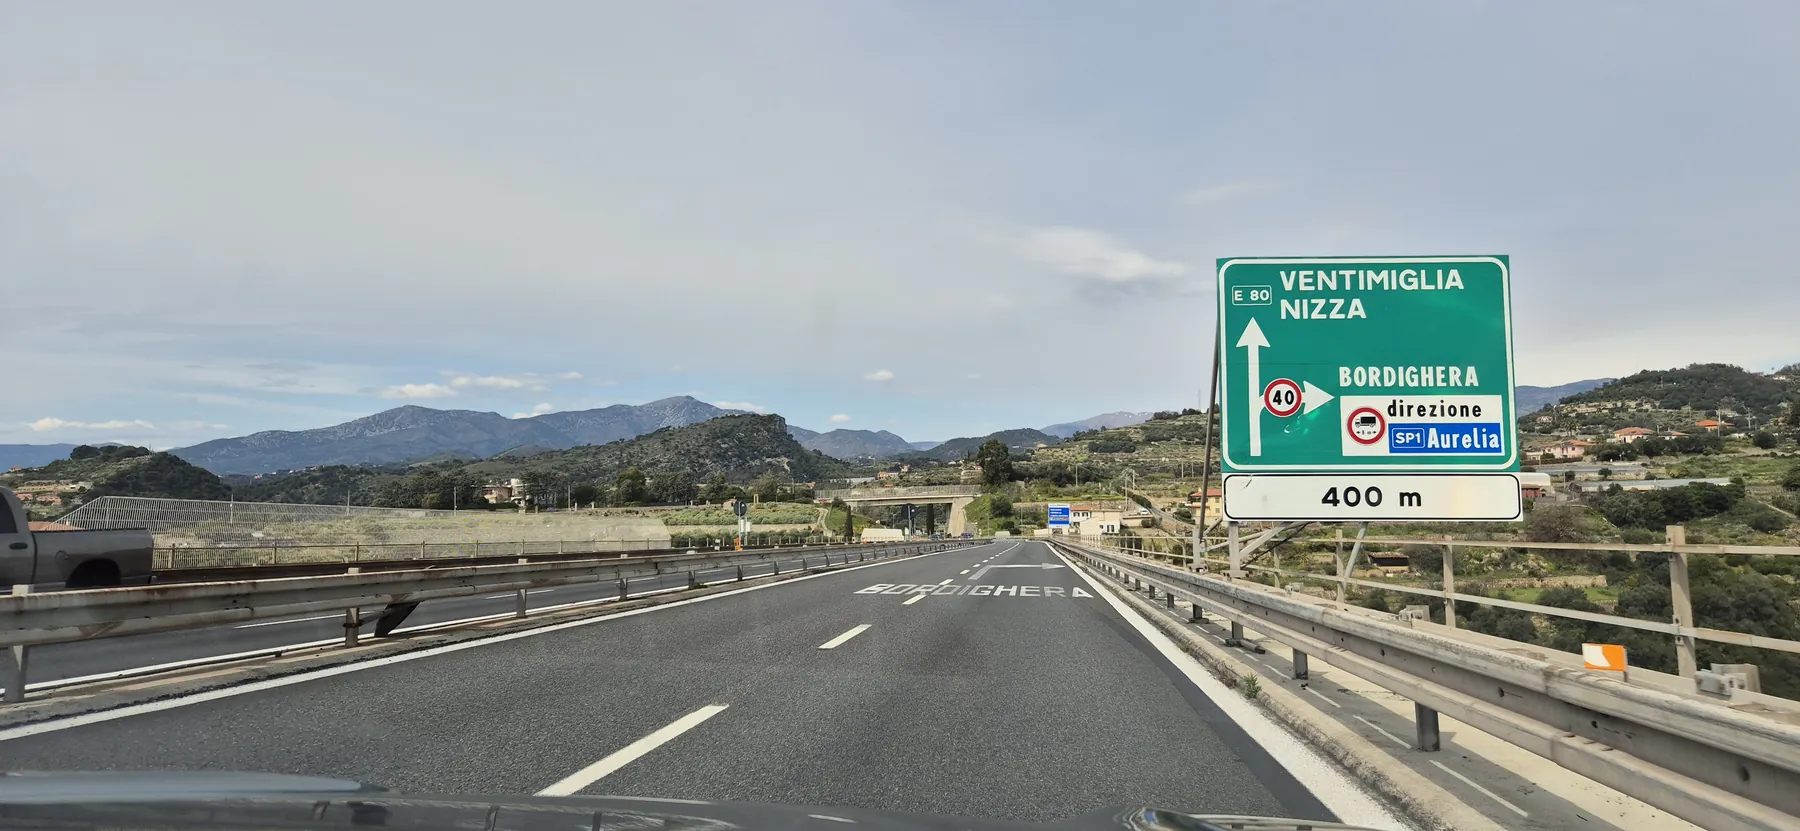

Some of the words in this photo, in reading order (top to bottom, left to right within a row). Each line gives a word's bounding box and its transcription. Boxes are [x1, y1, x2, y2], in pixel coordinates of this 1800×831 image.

[1279, 269, 1464, 291] VENTIMIGLIA
[1234, 290, 1243, 301] E
[1250, 289, 1270, 301] 80
[1280, 298, 1367, 320] NIZZA
[1339, 366, 1479, 387] BORDIGHERA
[1272, 390, 1295, 406] 40
[1387, 399, 1482, 418] direzione
[1395, 432, 1421, 444] SP1
[1427, 427, 1500, 449] Aurelia
[1321, 486, 1383, 507] 400
[1399, 491, 1422, 507] m
[853, 584, 1094, 598] BORDIGHERA
